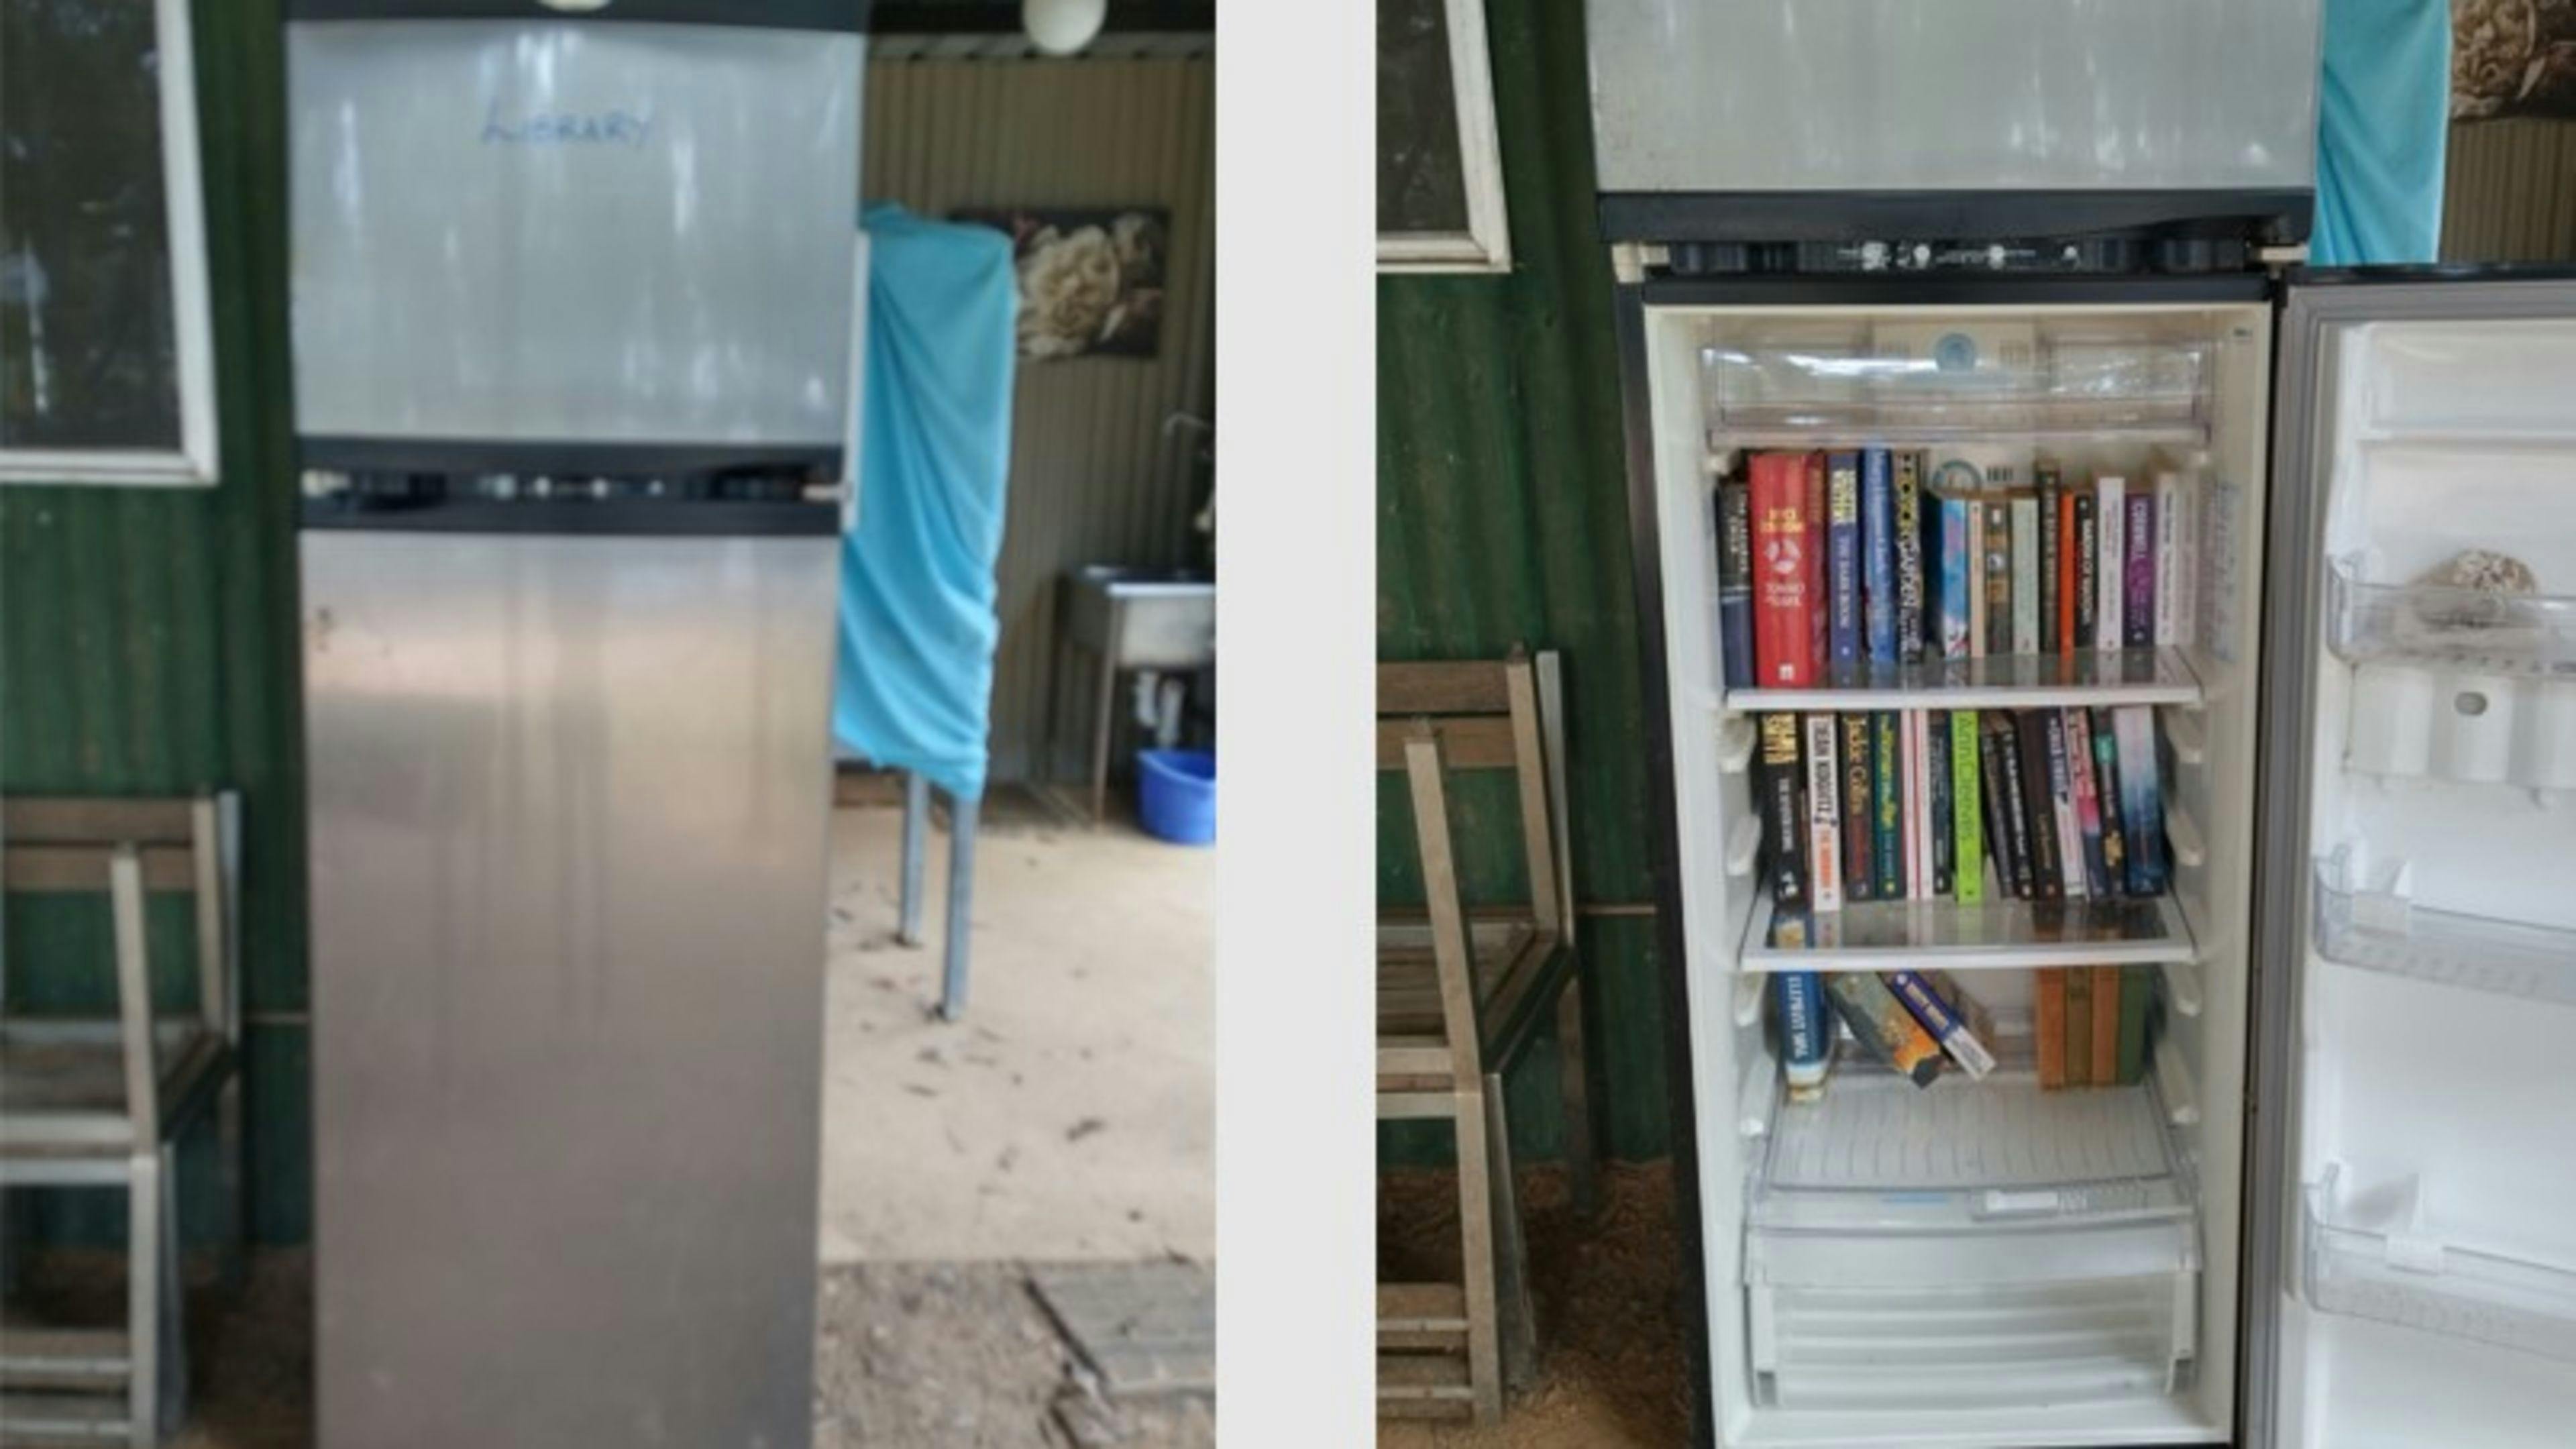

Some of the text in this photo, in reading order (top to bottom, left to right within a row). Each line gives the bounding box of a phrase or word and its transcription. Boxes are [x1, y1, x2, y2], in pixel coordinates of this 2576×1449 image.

[1842, 716, 1868, 764] Jackie
[1814, 720, 1832, 812] DEAN KOONTZ
[1849, 765, 1868, 816] Collins
